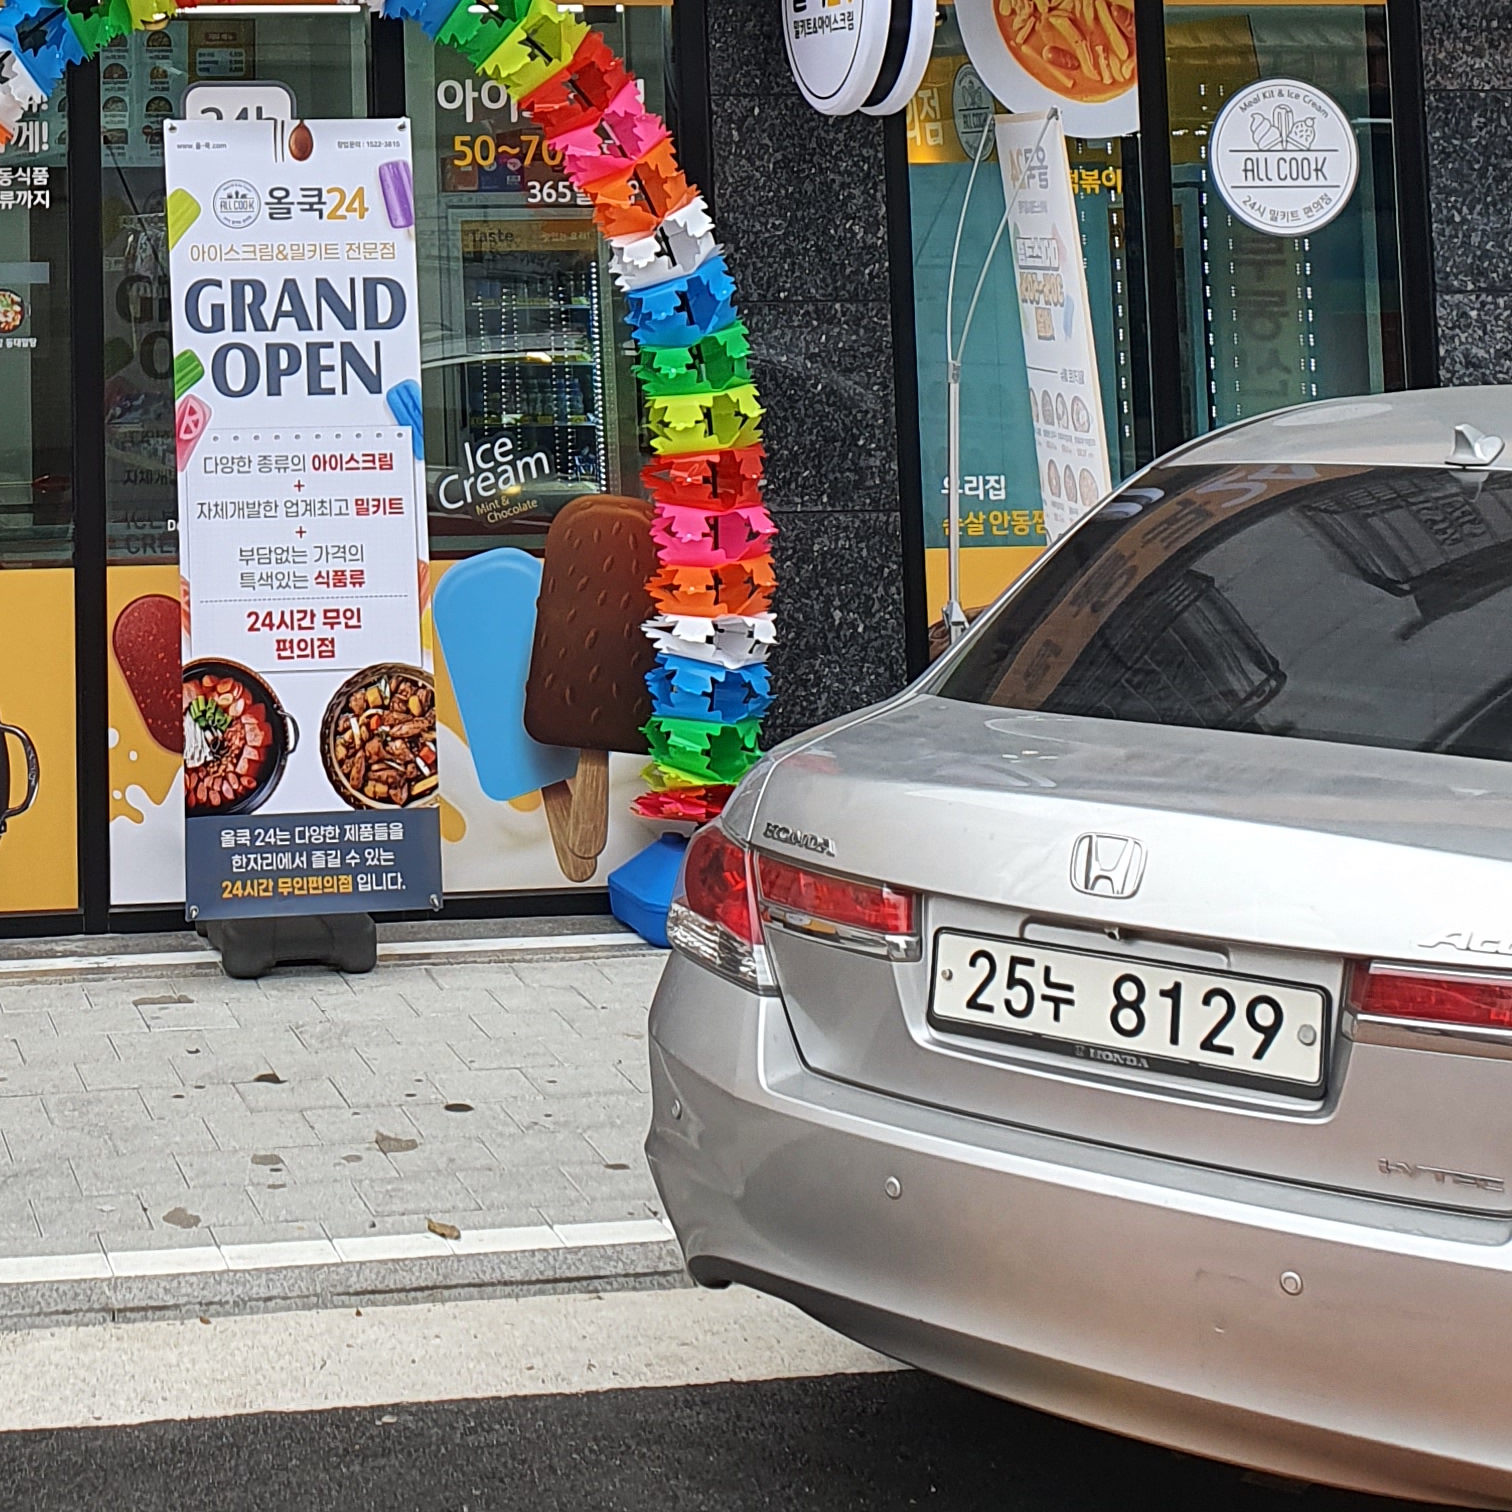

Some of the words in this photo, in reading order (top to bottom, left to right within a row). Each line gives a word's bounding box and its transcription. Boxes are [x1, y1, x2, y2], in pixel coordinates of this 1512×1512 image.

[793, 11, 854, 39] 밀키트&아이스크림
[1239, 95, 1261, 113] Meal
[1262, 90, 1275, 100] Kit
[1277, 89, 1284, 97] &
[1287, 89, 1300, 100] Ice
[1302, 94, 1329, 118] Cream
[1242, 156, 1272, 182] ALL
[1277, 156, 1328, 182] COOK
[265, 186, 369, 220] 올쿡24
[1242, 195, 1267, 218] 24시
[1269, 209, 1301, 223] 밀키트
[1302, 192, 1333, 218] 편의점
[190, 243, 340, 263] 아이스크림&밀키트
[345, 241, 396, 261] 전문점
[184, 276, 407, 334] GRAND
[211, 341, 383, 398] OPEN
[203, 456, 252, 475] 다양한
[257, 454, 306, 473] 종류의
[311, 453, 393, 471] 아이스크림
[464, 437, 514, 473] Ice
[438, 450, 550, 510] Cream
[197, 499, 279, 520] 자체개발한
[284, 498, 349, 518] 업계최고
[354, 497, 404, 516] 밀키트
[476, 499, 500, 515] Mint
[487, 497, 538, 523] Chocolate
[239, 546, 308, 566] 부담없는
[313, 544, 364, 564] 가격의
[239, 571, 309, 591] 특색있는
[314, 569, 365, 588] 식품류
[246, 608, 316, 633] 24시간
[322, 607, 362, 630] 무인
[275, 637, 336, 660] 편의점
[221, 829, 251, 848] 올쿡
[254, 827, 291, 846] 24는
[295, 824, 340, 844] 다양한
[344, 822, 404, 842] 제품들을
[763, 822, 836, 857] HONDA
[232, 852, 307, 872] 한자리에서
[311, 850, 341, 869] 즐길
[345, 849, 361, 867] 수
[365, 847, 395, 866] 있는
[222, 877, 273, 899] 24시간
[277, 874, 353, 896] 무인편의점
[356, 872, 406, 892] 입니다.
[965, 949, 1076, 1024] 25누
[1110, 972, 1286, 1062] 8129
[1089, 1048, 1149, 1068] HONDA
